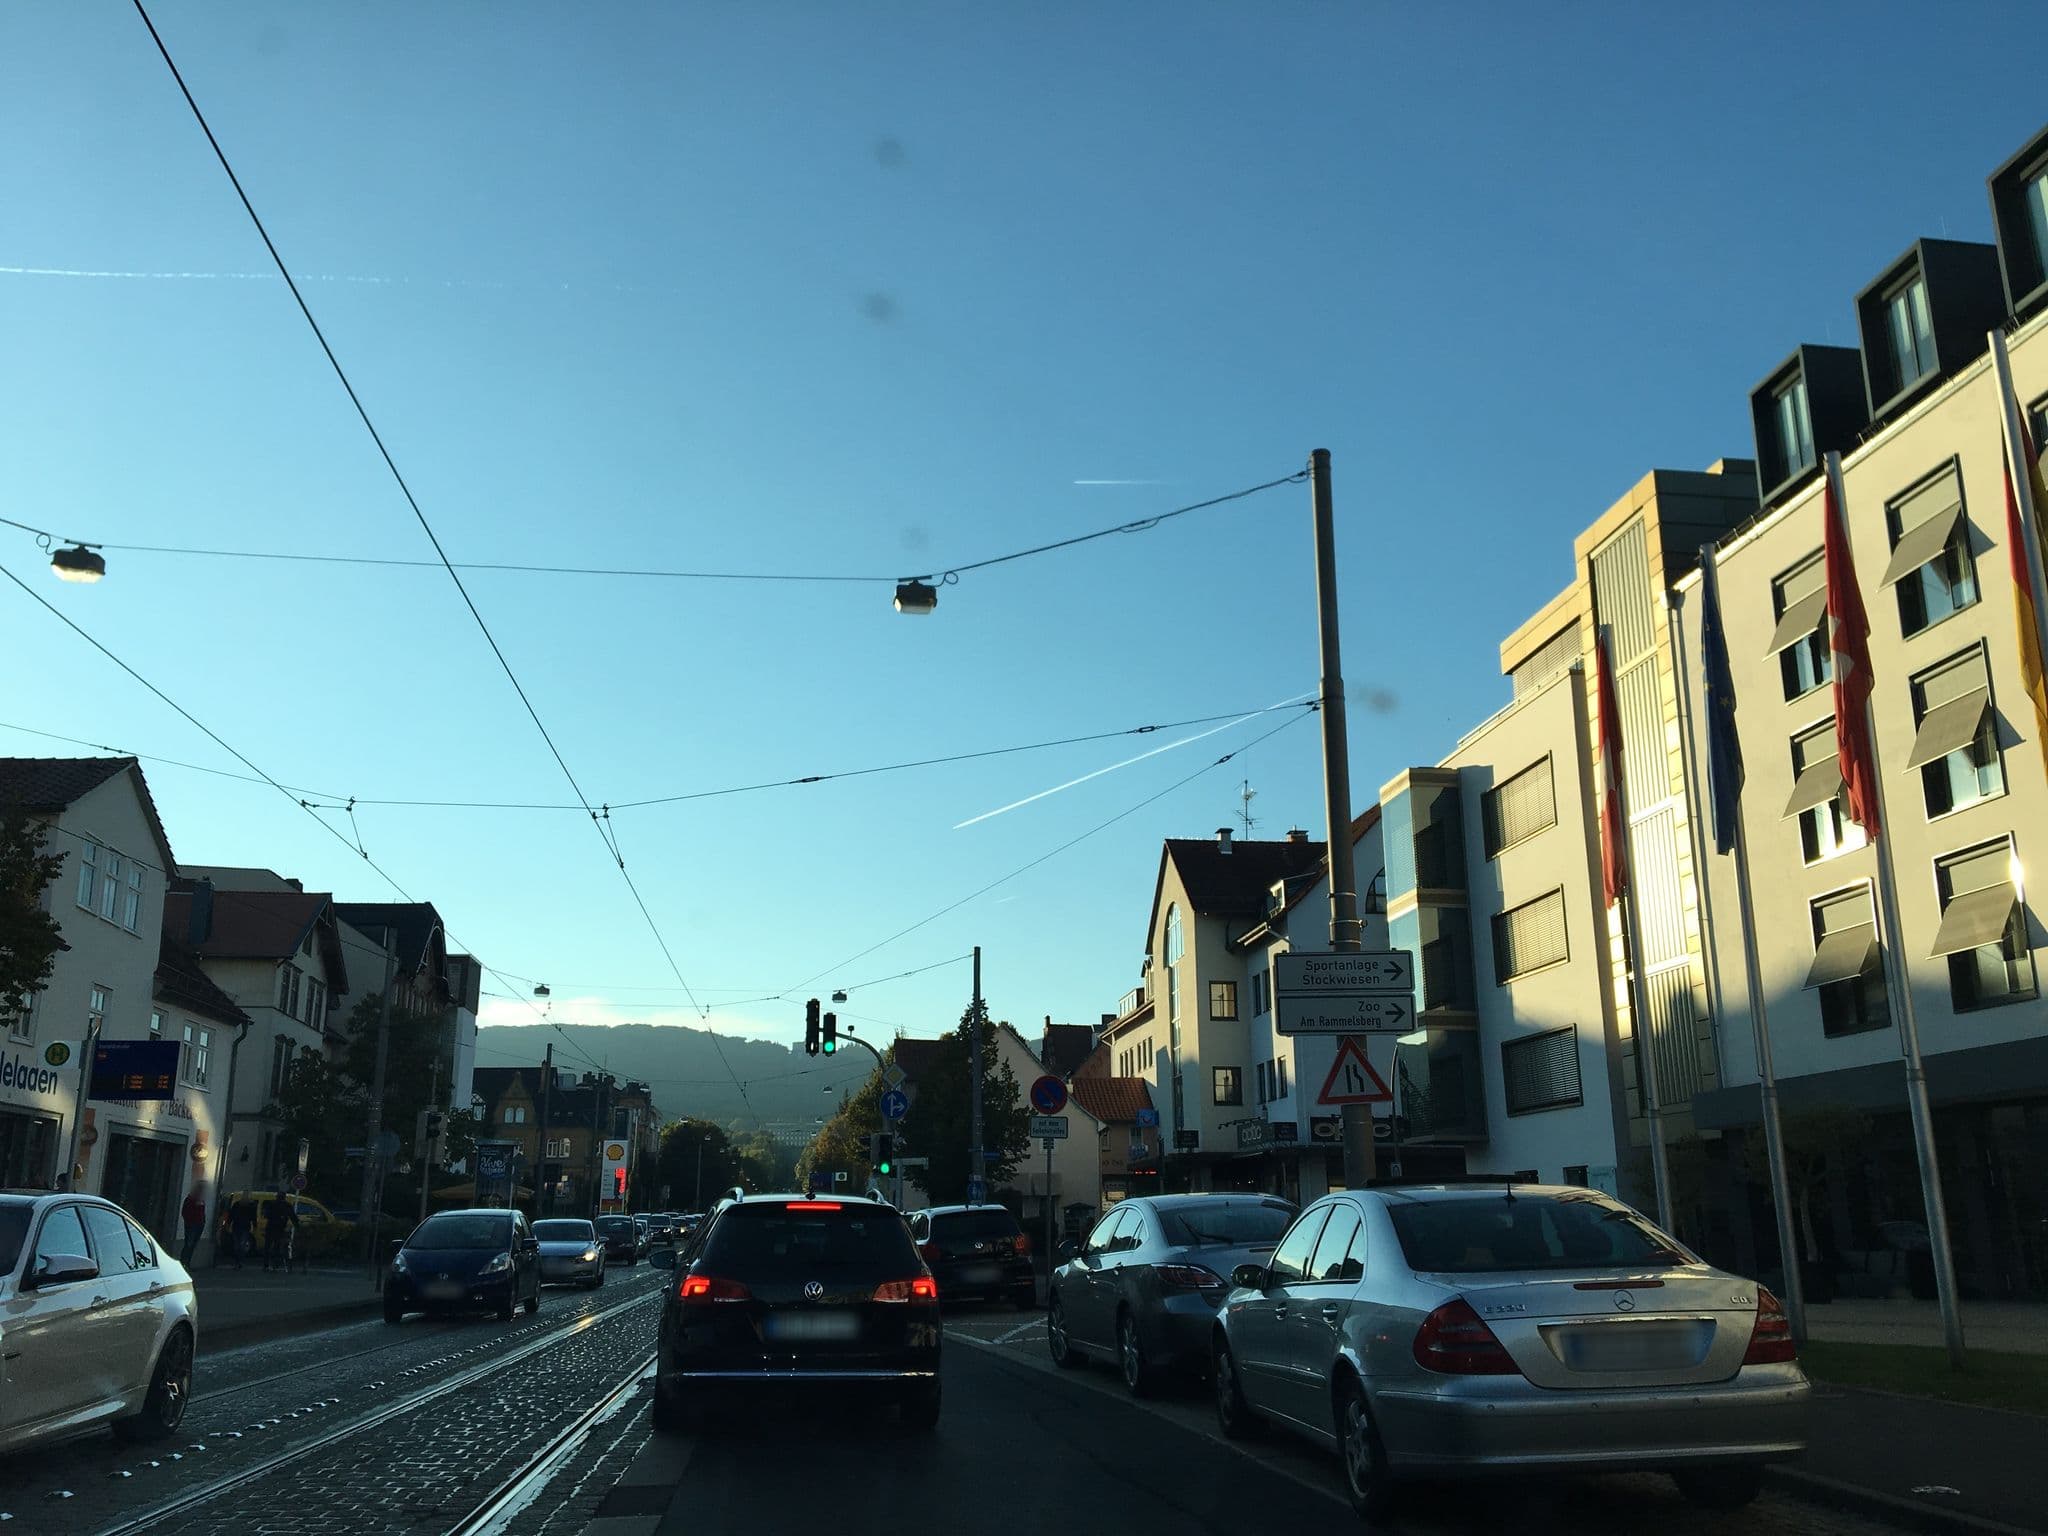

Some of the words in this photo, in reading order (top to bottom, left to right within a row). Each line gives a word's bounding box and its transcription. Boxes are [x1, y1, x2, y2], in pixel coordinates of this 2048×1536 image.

[1305, 960, 1379, 973] Sportanlage
[1303, 974, 1380, 985] Stockwiesen
[1358, 1000, 1380, 1011] Zoo
[1301, 1017, 1315, 1027] Am
[1319, 1016, 1381, 1028] Rammelsberg
